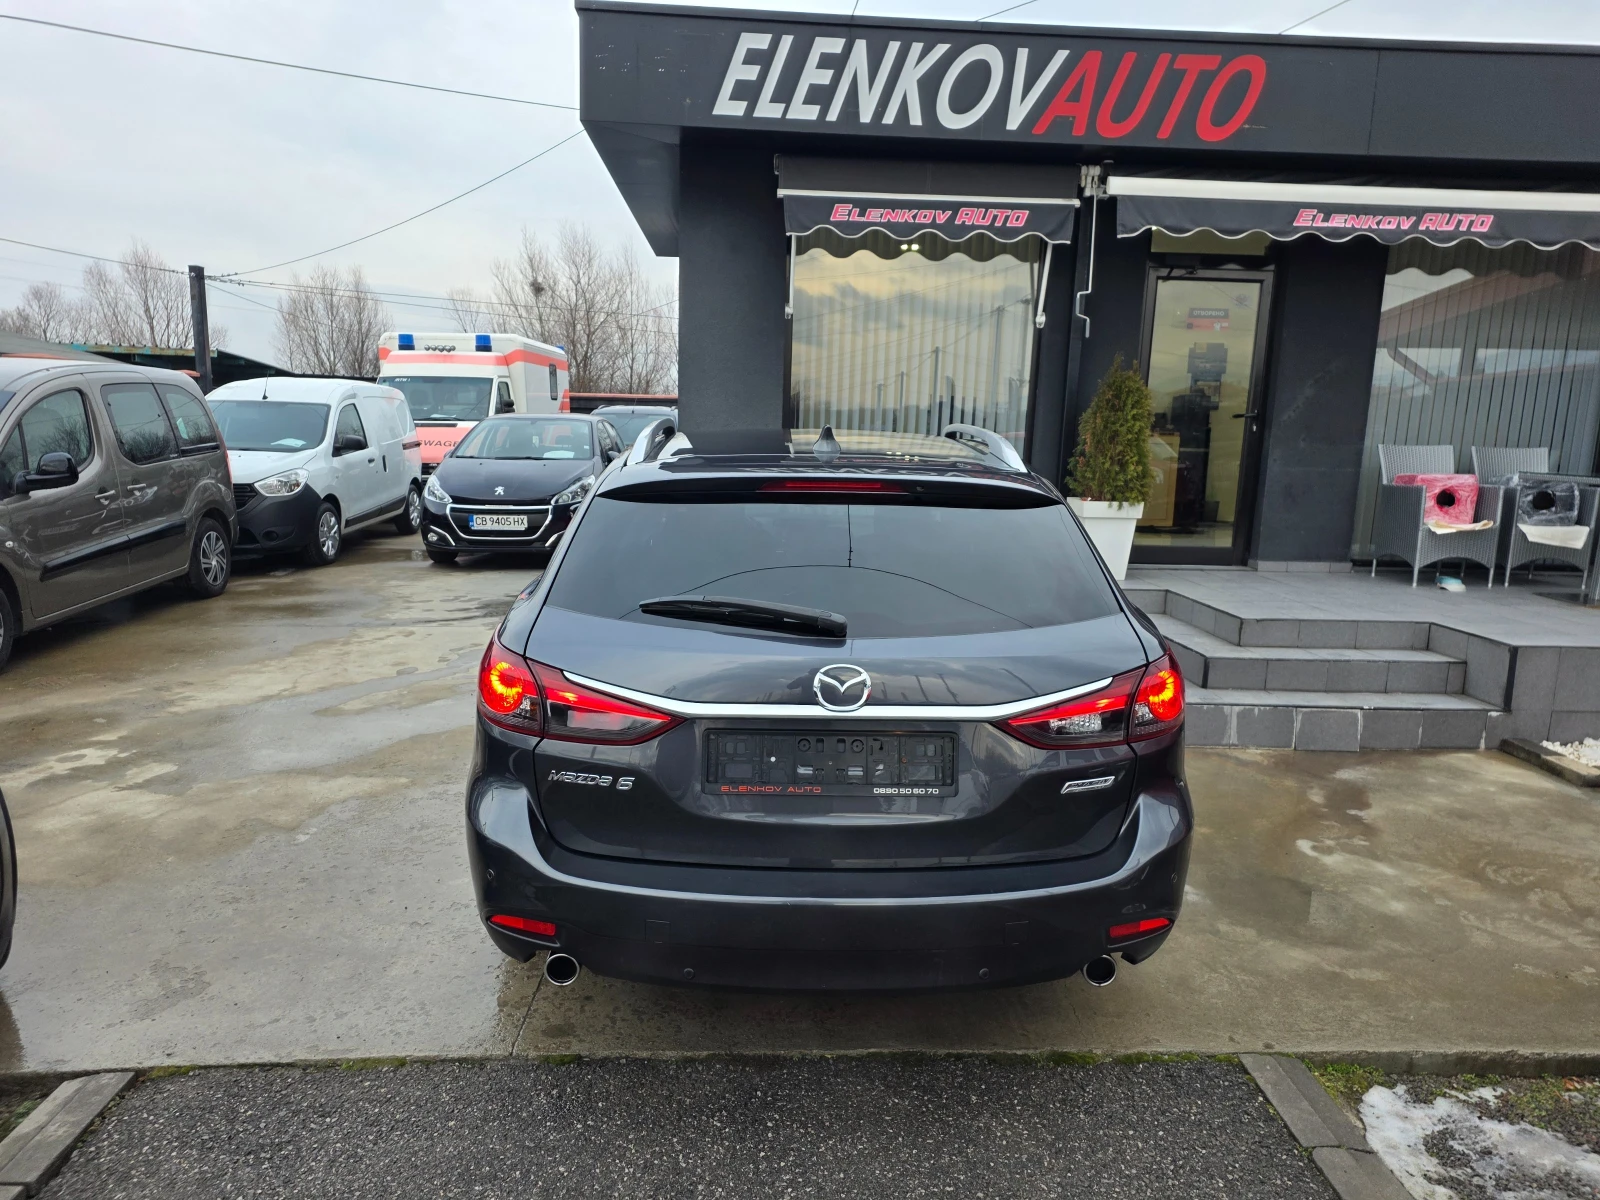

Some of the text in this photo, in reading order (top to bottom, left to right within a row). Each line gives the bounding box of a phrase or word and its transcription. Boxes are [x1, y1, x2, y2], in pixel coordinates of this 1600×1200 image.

[830, 203, 1030, 227] ELENKOV AUTO
[1293, 208, 1495, 232] ELENKOV AUTO
[475, 516, 488, 526] CB
[489, 517, 512, 526] 9405
[513, 517, 526, 526] HX
[615, 776, 635, 790] 6
